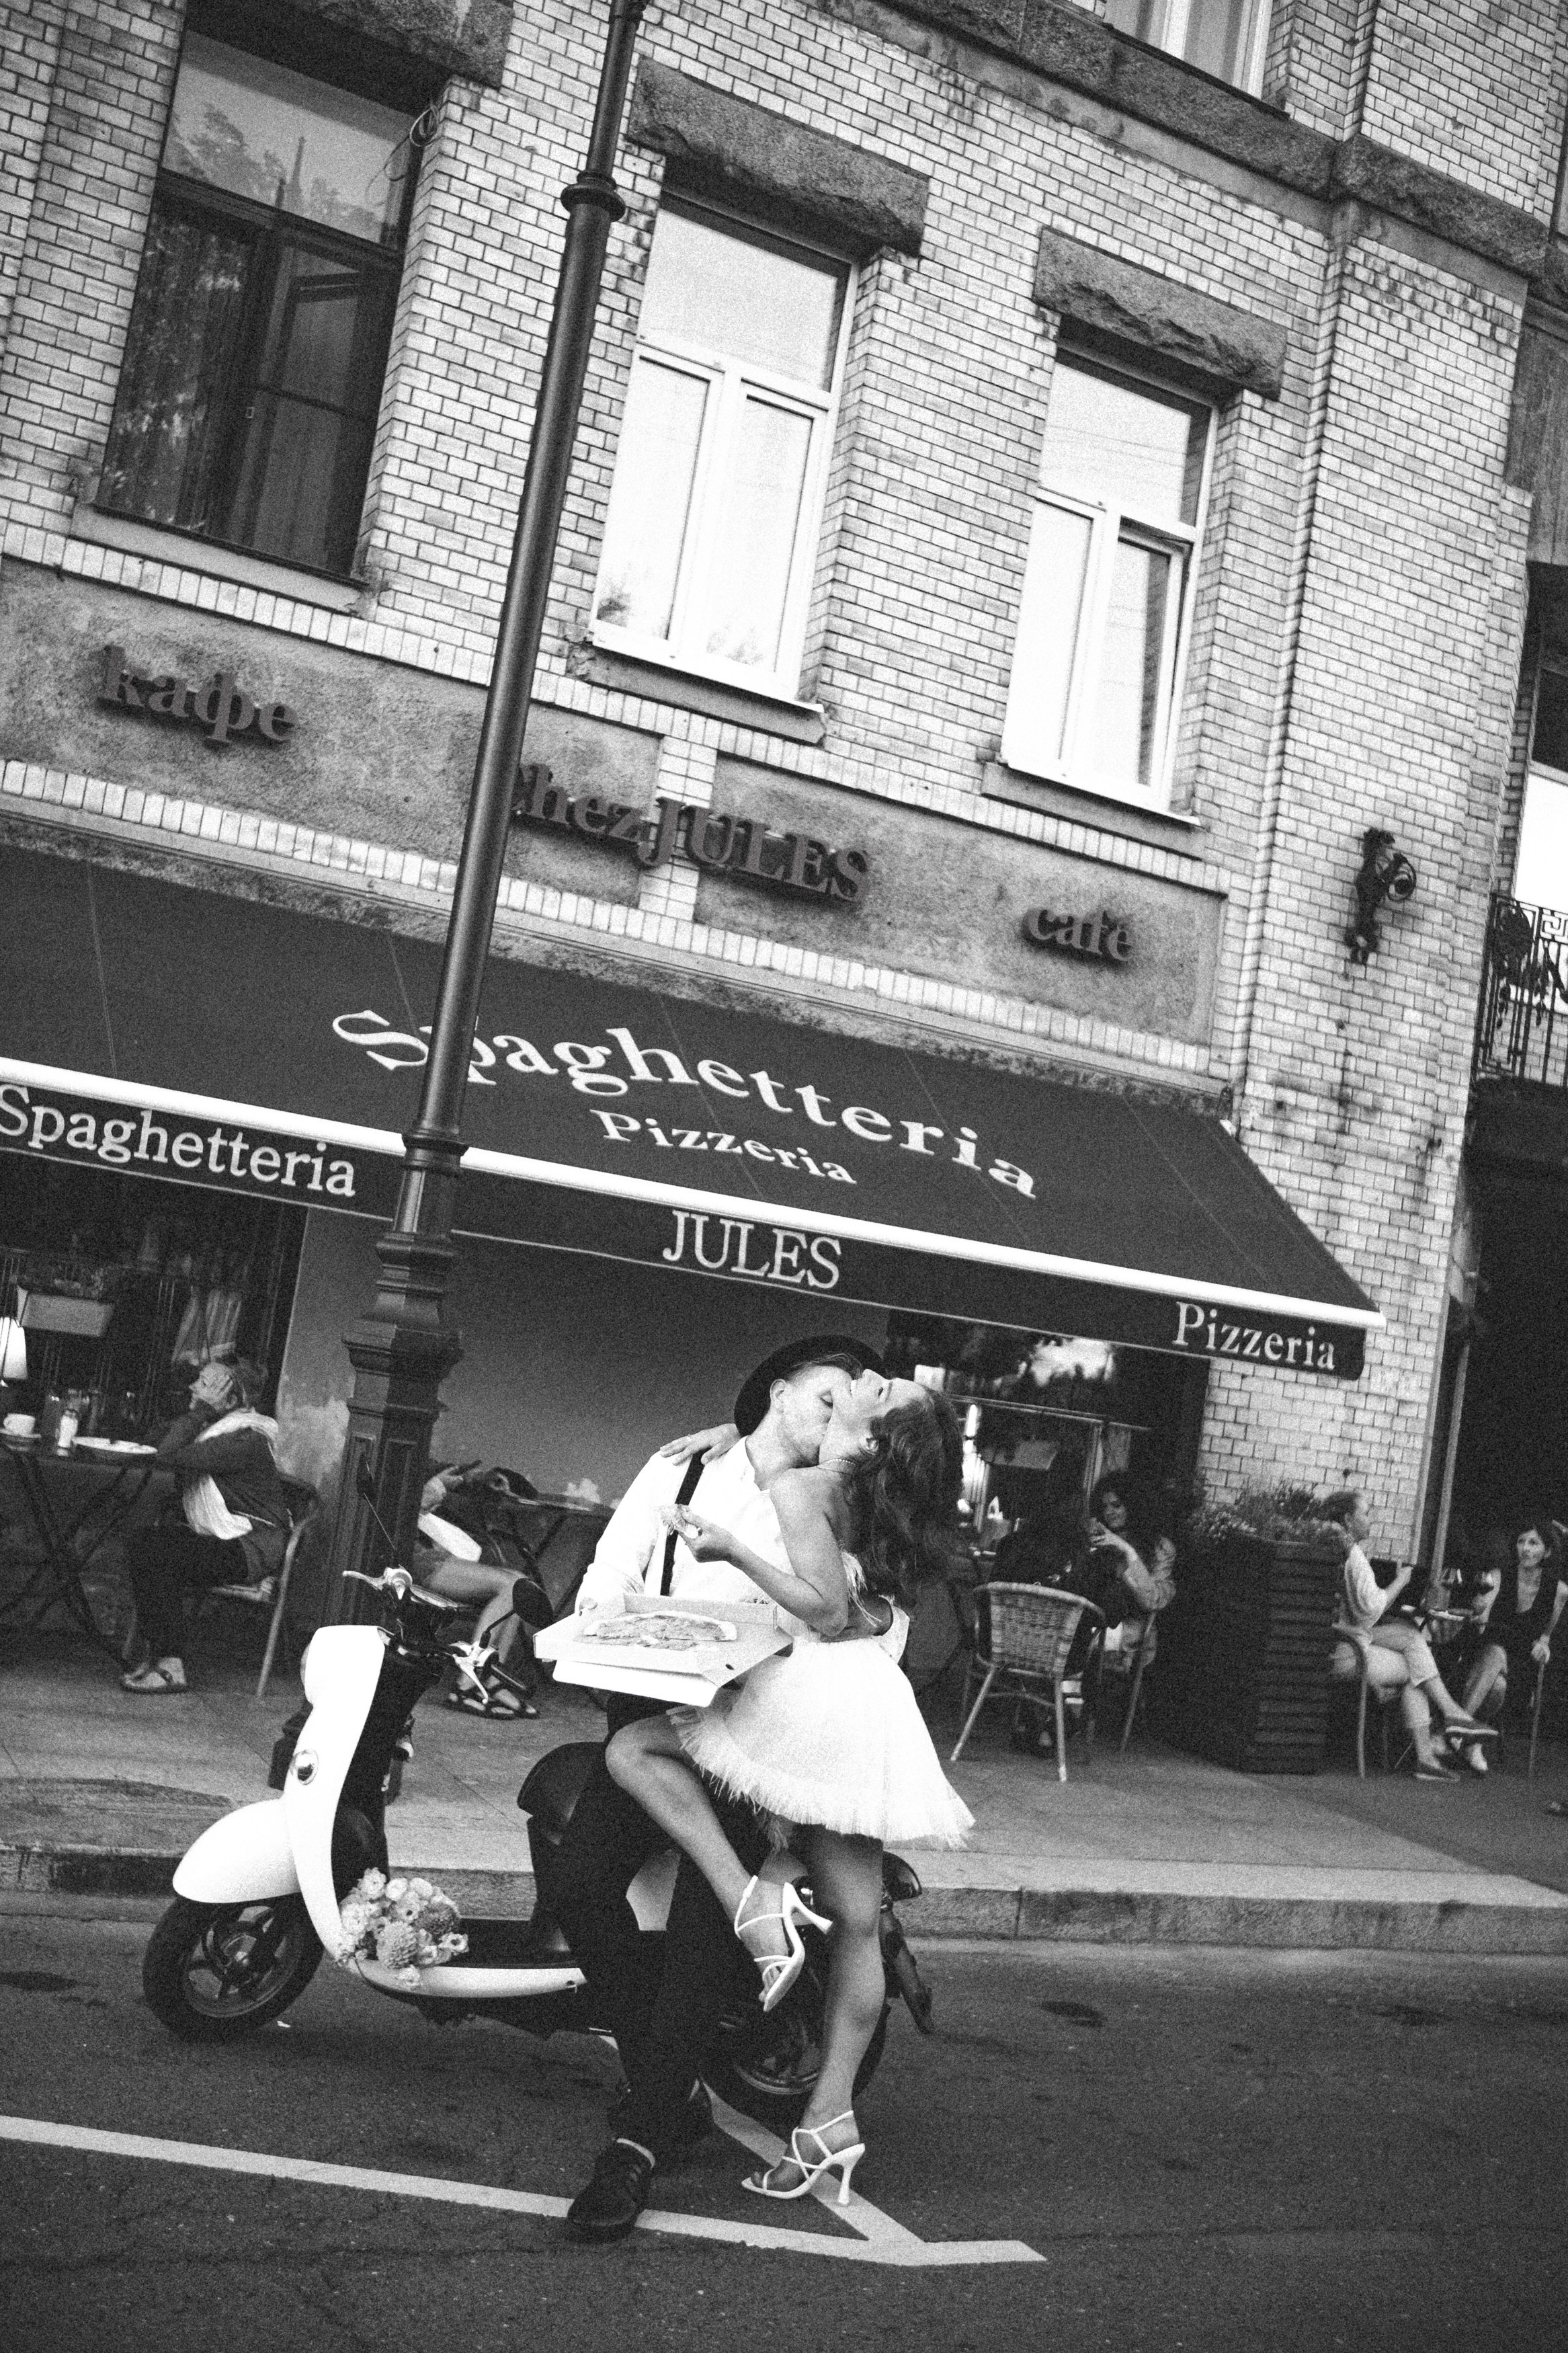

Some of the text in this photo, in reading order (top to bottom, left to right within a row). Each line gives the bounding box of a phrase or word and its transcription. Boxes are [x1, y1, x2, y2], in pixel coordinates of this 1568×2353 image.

[512, 763, 871, 902] hez JULES
[0, 1084, 356, 1197] Spaghetteria
[589, 1109, 857, 1185] Pizzeria
[663, 1210, 841, 1289] JULES
[1173, 1301, 1335, 1371] Pizzeria
